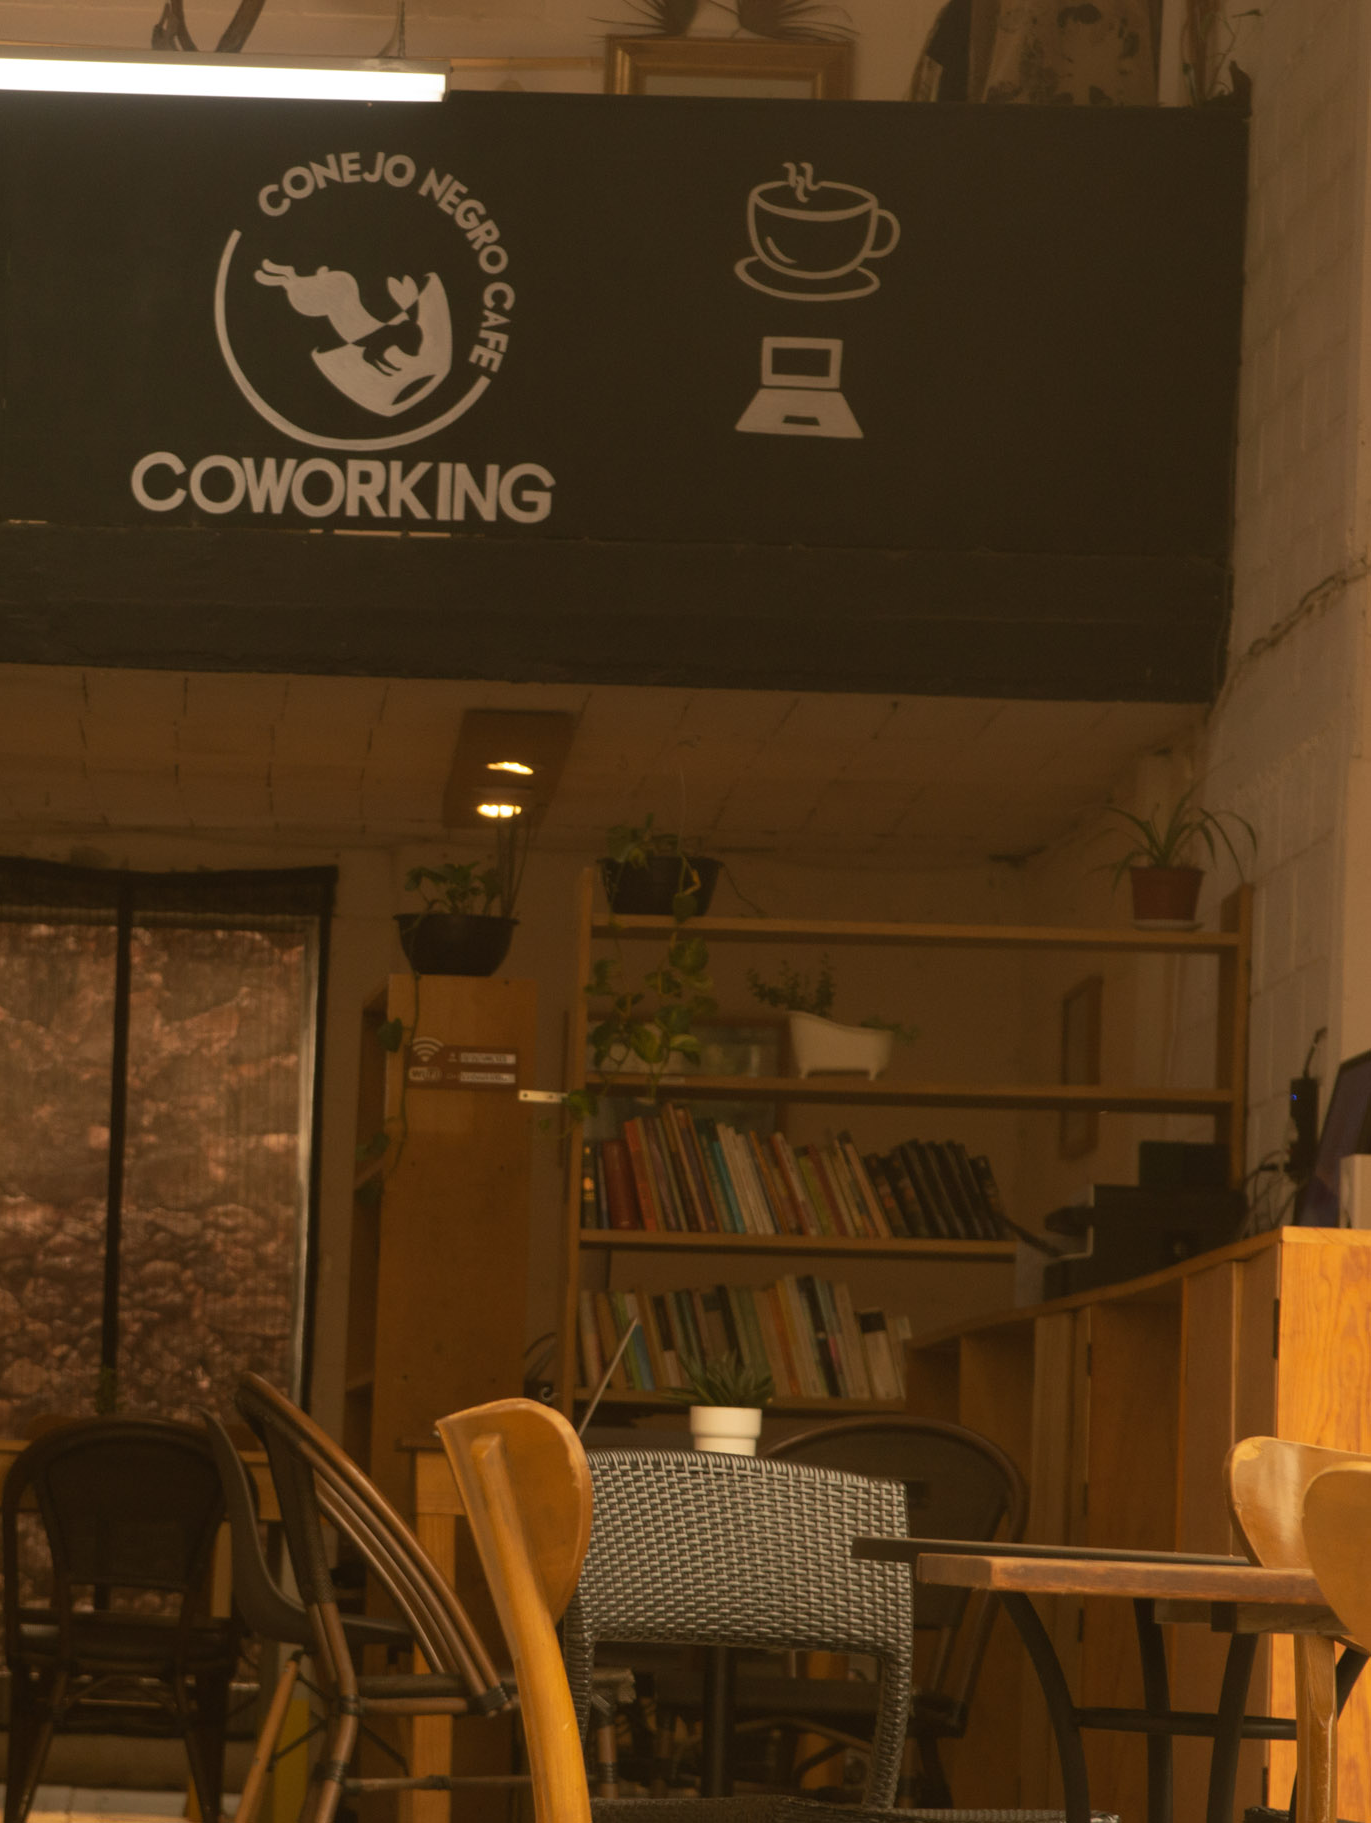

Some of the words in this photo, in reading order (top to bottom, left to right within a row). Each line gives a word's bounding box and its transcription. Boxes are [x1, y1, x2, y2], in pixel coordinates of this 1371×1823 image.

[258, 151, 416, 217] CONEJO
[418, 168, 509, 275] NEGRO
[467, 281, 516, 374] CAFE
[131, 451, 557, 524] COWORKING
